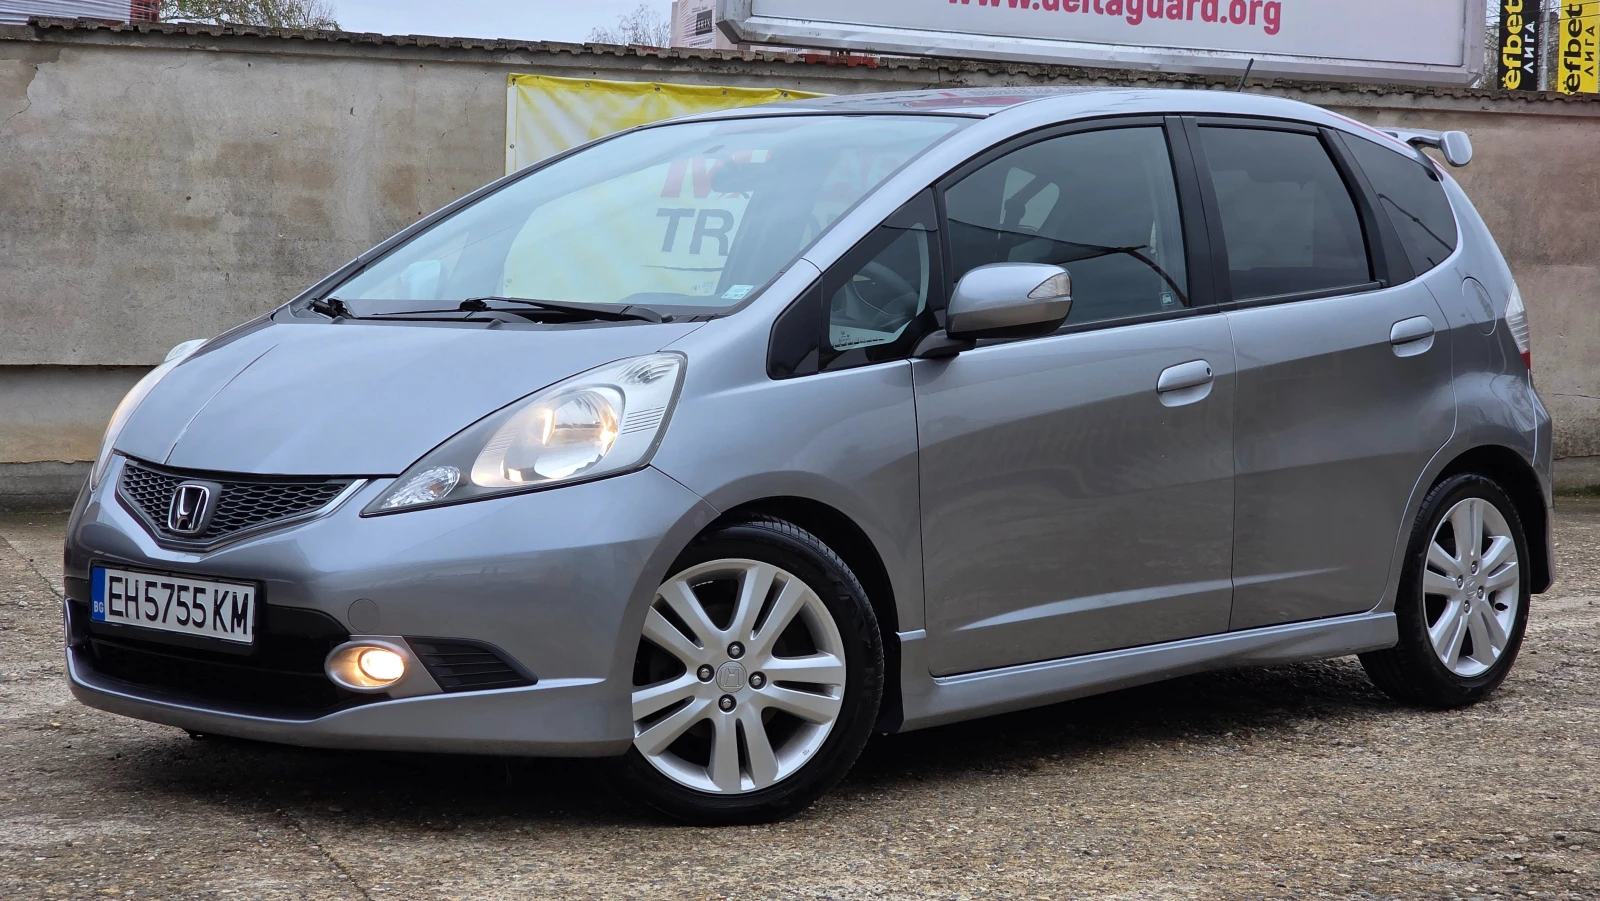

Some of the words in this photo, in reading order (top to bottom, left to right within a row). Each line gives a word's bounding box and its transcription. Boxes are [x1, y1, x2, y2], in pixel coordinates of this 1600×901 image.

[948, 0, 1282, 35] .eaguard.org
[1563, 4, 1583, 92] efbet
[93, 600, 104, 613] BG
